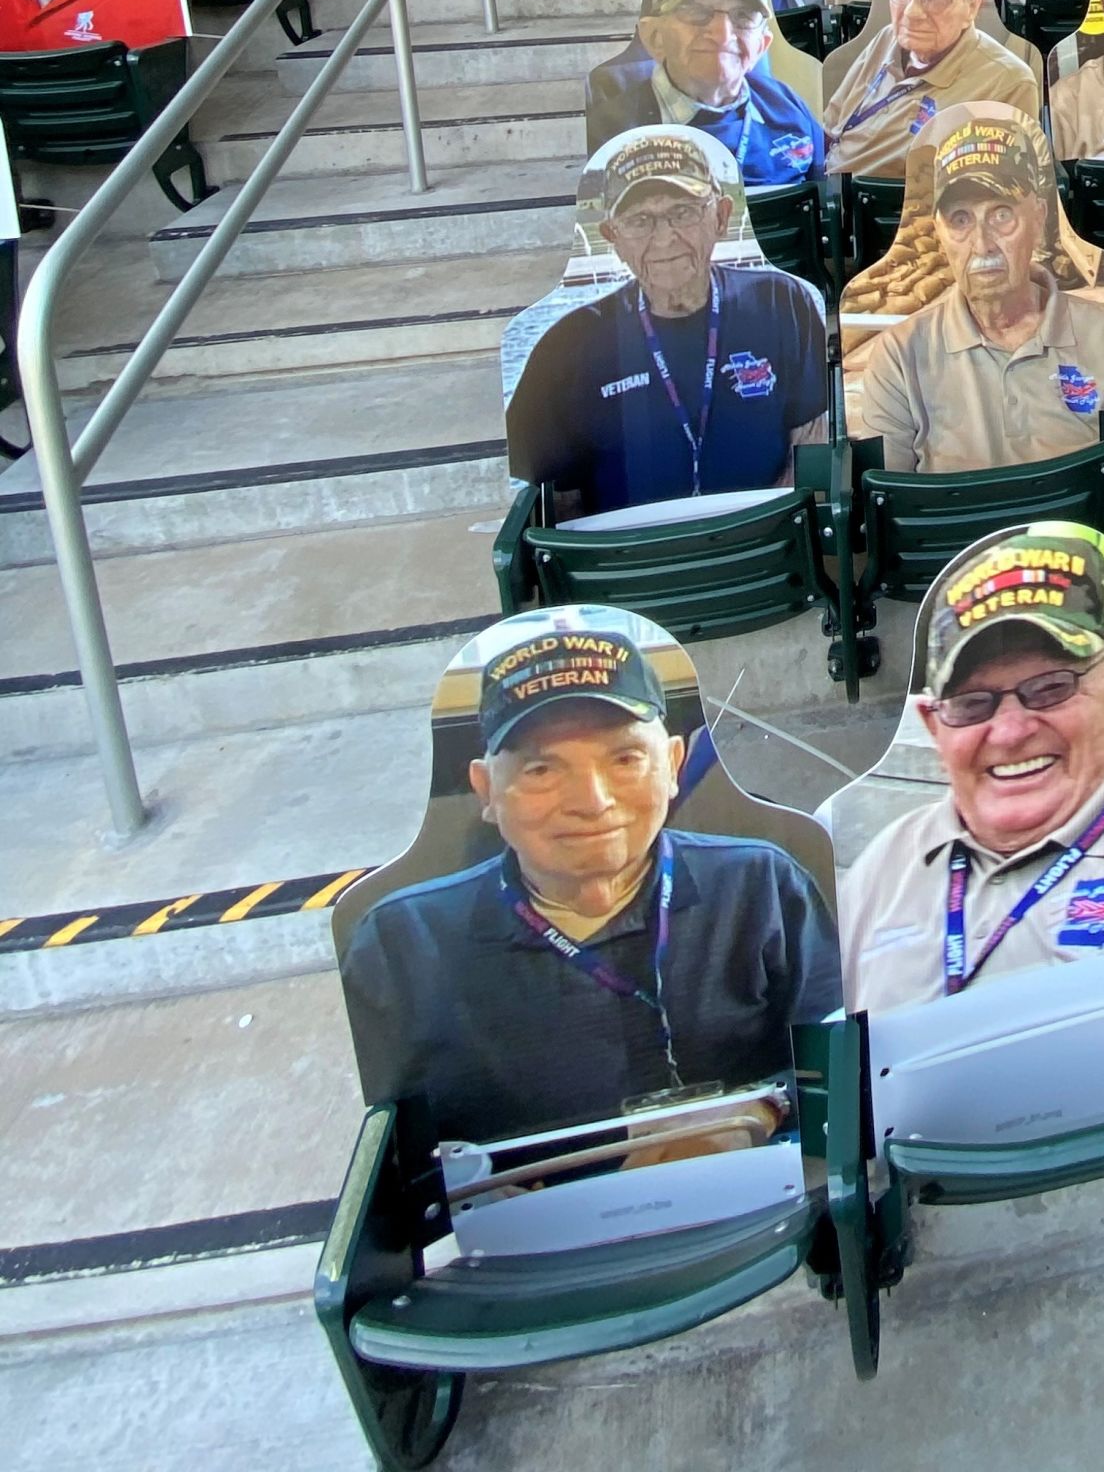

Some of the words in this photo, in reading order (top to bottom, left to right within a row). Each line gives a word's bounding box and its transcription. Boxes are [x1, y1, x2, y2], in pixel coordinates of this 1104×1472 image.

[609, 136, 650, 171] WORLD
[652, 138, 681, 150] WAR
[936, 121, 972, 160] WORLD
[974, 126, 1005, 142] WAR
[1006, 135, 1015, 147] II
[624, 160, 681, 181] VETERAN
[946, 153, 1000, 175] VETERAN
[652, 350, 671, 380] FLIGHT
[704, 357, 716, 389] FLIGHT
[601, 372, 650, 398] VETERAN
[1018, 548, 1070, 572] WAR
[958, 588, 1064, 628] VETERAN
[489, 636, 560, 680] WORLD
[562, 635, 614, 656] WAR
[616, 646, 630, 663] II
[513, 669, 610, 700] VETERAN
[1033, 846, 1083, 895] FLIGHT
[542, 927, 582, 958] FLIGHT
[946, 932, 965, 977] FLIGHT
